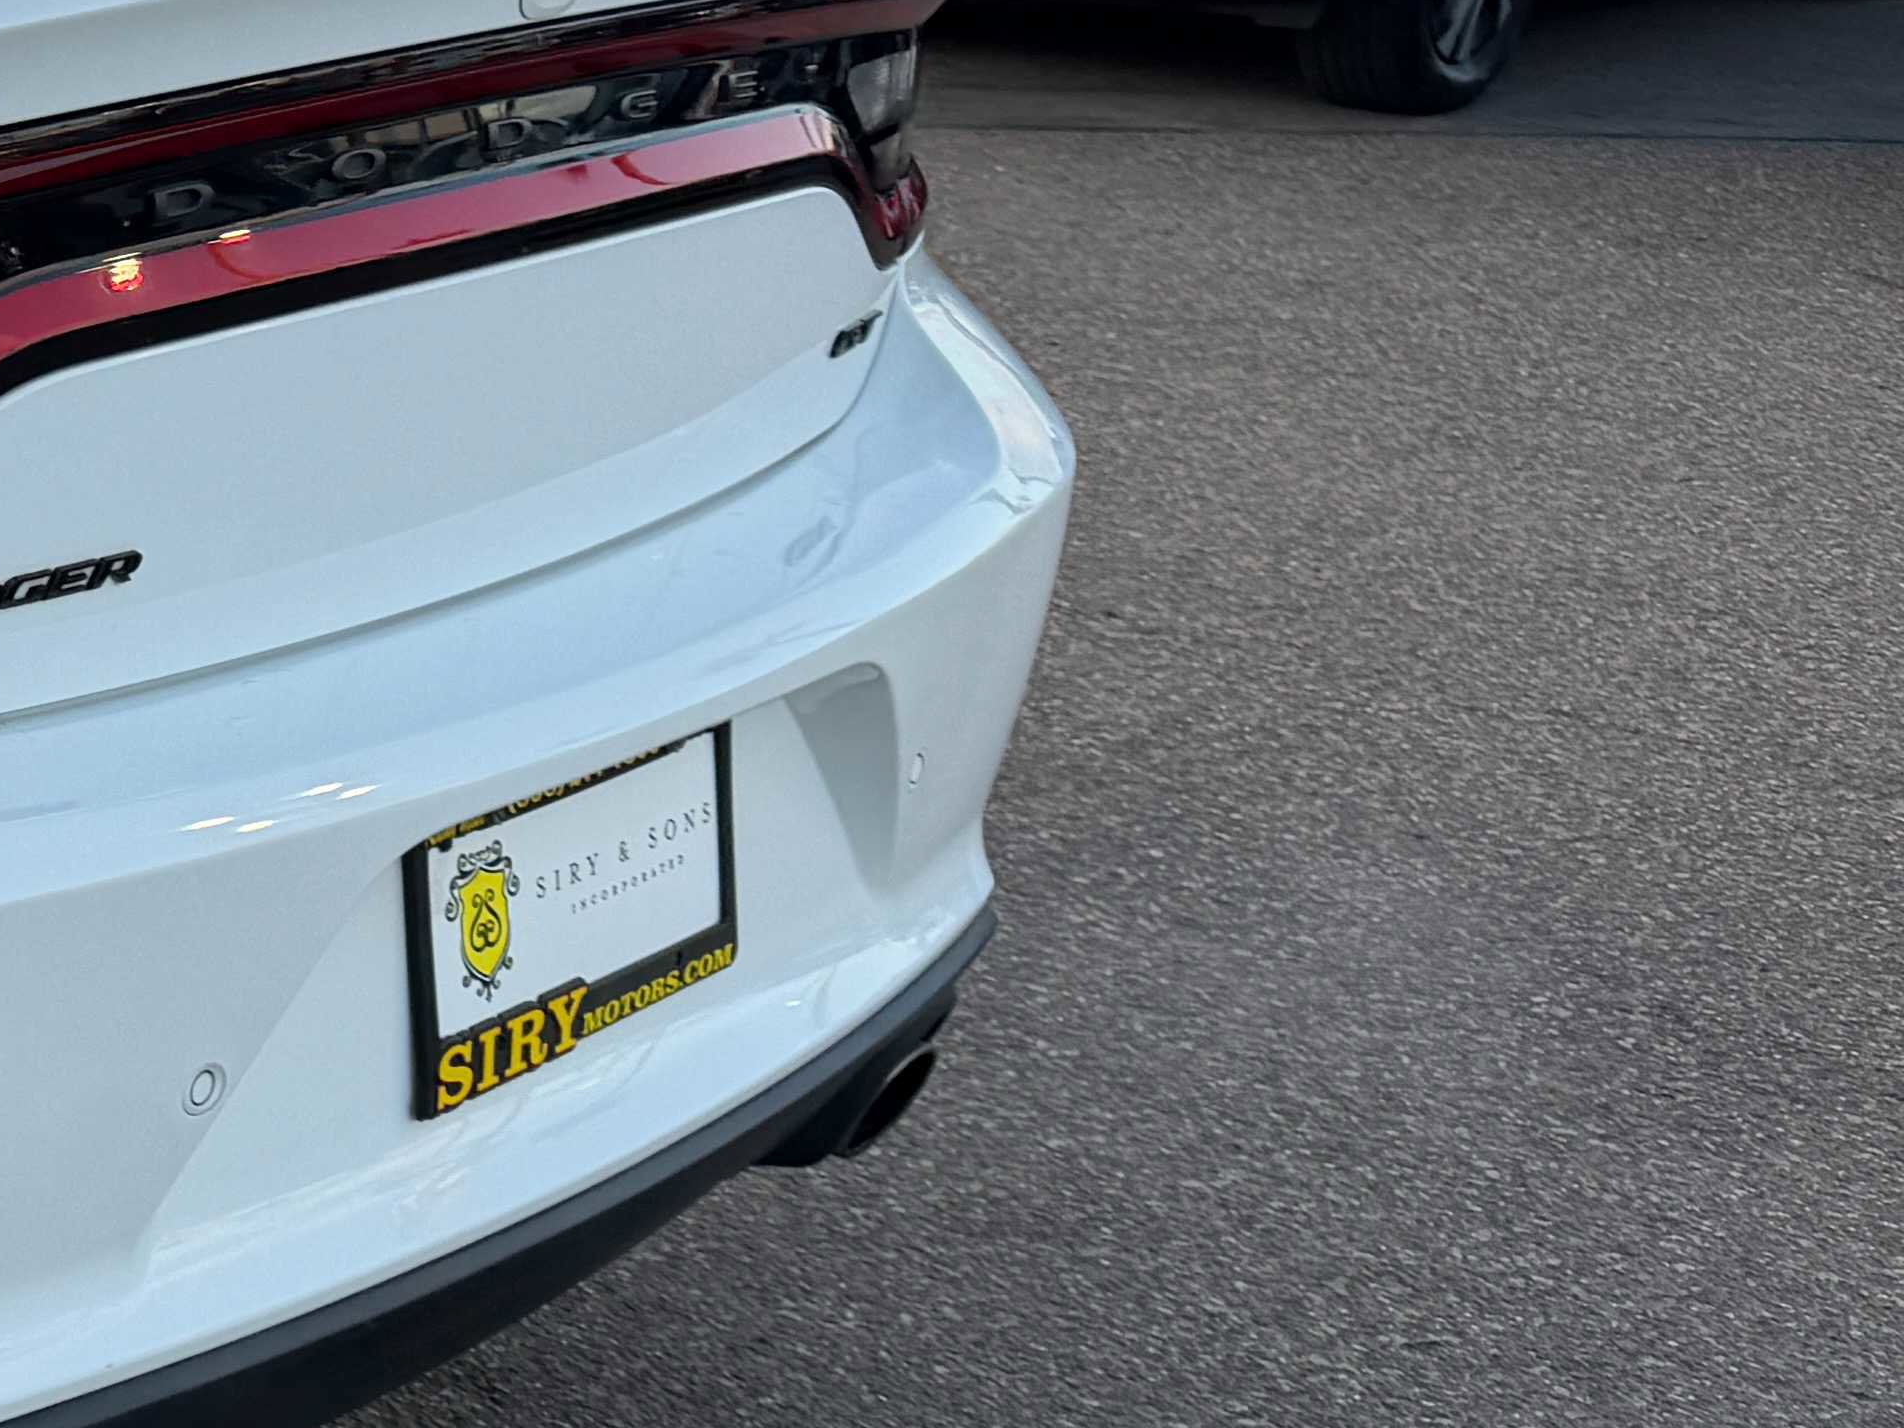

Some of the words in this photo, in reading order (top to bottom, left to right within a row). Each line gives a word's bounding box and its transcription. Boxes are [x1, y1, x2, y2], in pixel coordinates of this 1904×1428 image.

[151, 67, 761, 227] DODGE
[535, 852, 599, 900] SIRY
[618, 841, 631, 863] &
[647, 801, 712, 850] SONS
[571, 853, 685, 915] INCORPORATED
[436, 984, 590, 1113] SIRY
[581, 942, 735, 1037] MOTORS.COM
